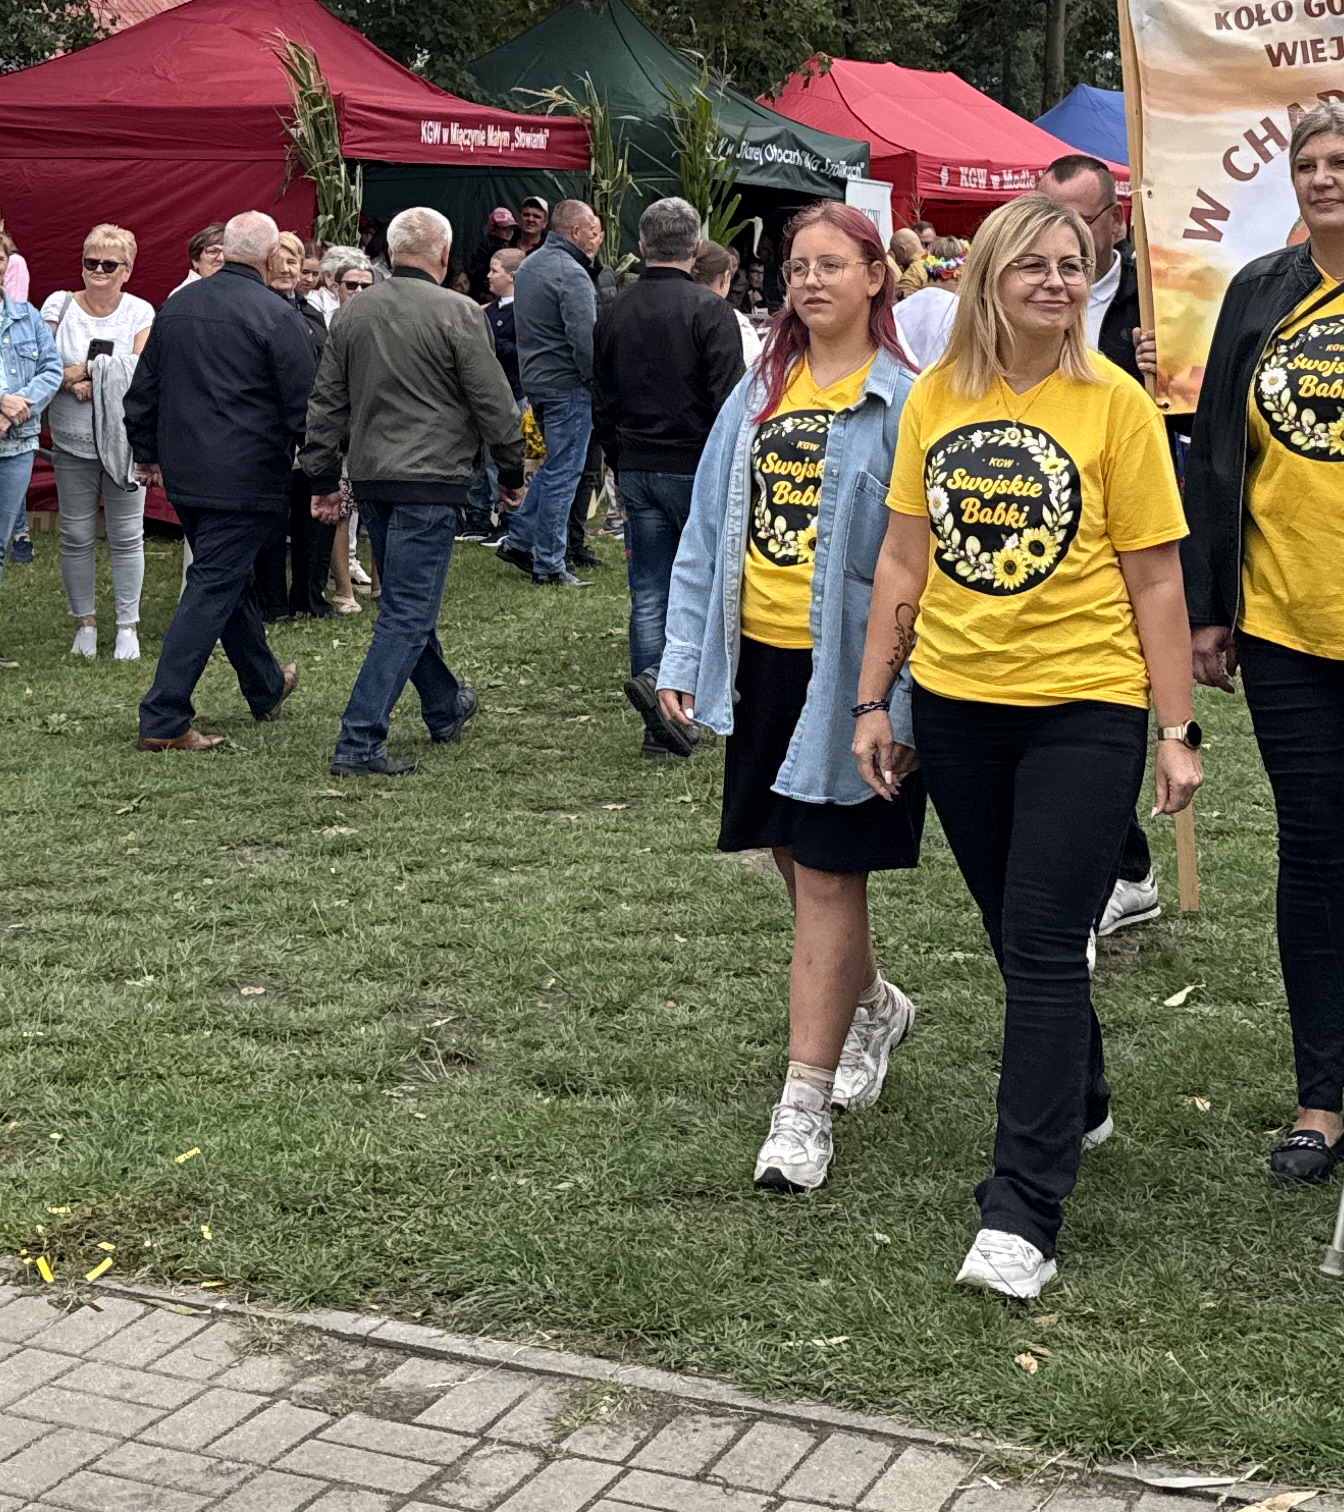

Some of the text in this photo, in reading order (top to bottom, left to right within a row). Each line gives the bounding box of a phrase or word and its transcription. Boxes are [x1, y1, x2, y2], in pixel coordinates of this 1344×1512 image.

[1214, 0, 1294, 31] KOŁO
[420, 119, 441, 144] KGW
[442, 127, 450, 145] w
[959, 166, 988, 189] KGW
[990, 174, 1000, 190] w
[1181, 187, 1232, 244] W
[796, 440, 821, 451] KGW
[761, 451, 825, 483] Swojsk
[988, 456, 1015, 468] KGW
[946, 467, 1044, 499] Swojskie
[959, 496, 1031, 529] Babki
